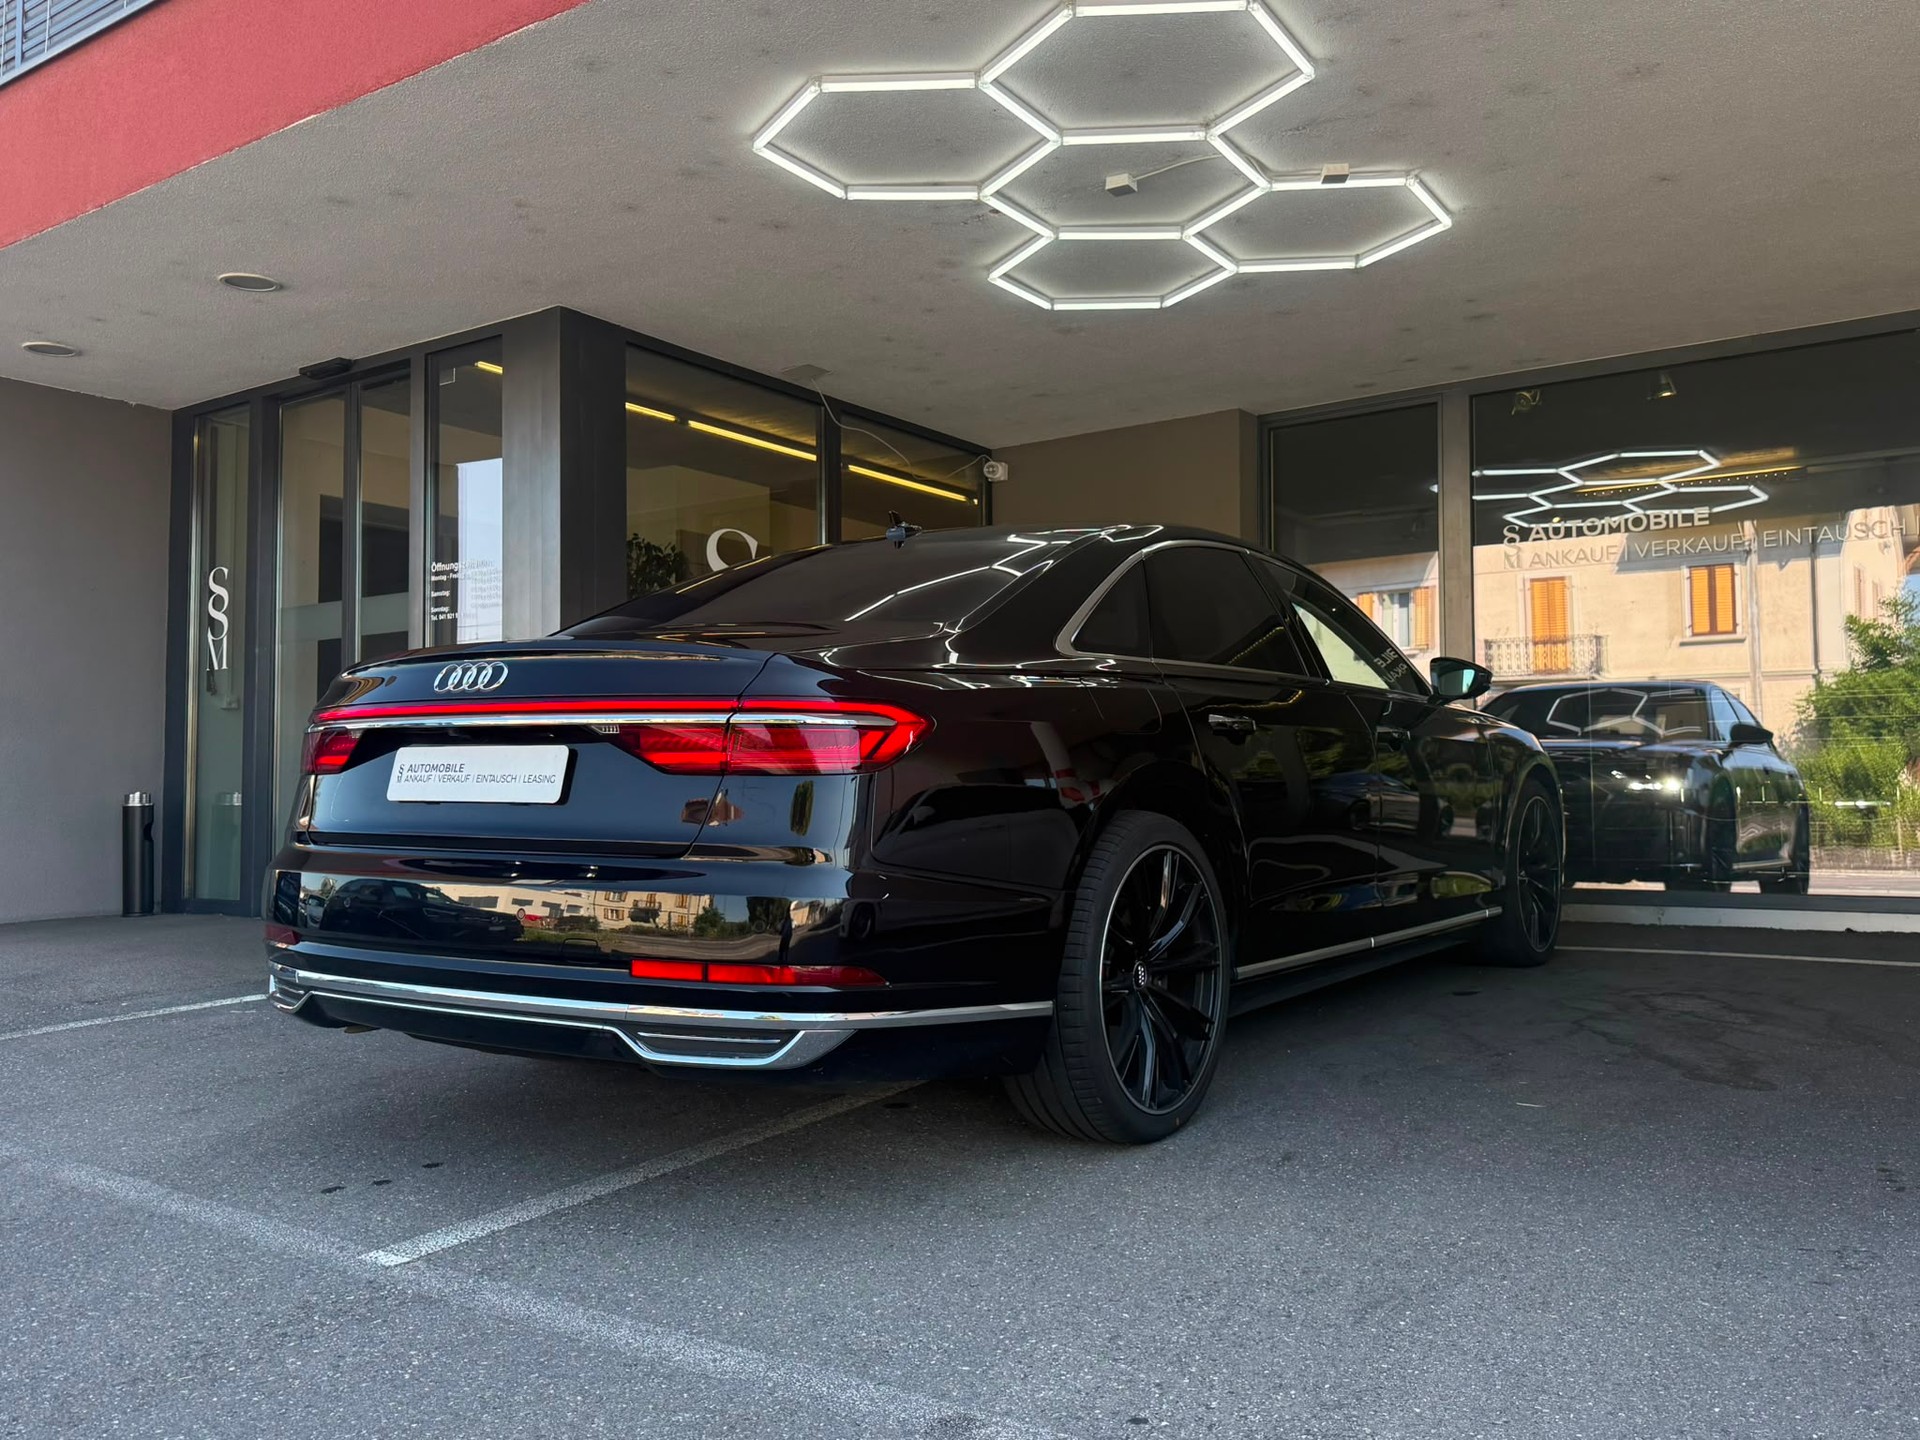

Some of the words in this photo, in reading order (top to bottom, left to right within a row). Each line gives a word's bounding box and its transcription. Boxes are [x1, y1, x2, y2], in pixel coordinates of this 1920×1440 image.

[1528, 506, 1710, 542] AUTOMOBILE
[1529, 544, 1619, 568] ANKAUF
[1634, 532, 1746, 559] VERKAUF
[1763, 518, 1906, 548] EINTAUSCH
[404, 774, 433, 783] ANKAUF
[437, 774, 471, 783] VERKAUF
[475, 774, 518, 784] EINTAUSCH
[522, 774, 556, 784] LEASING
[407, 763, 465, 773] AUTOMOBILE
